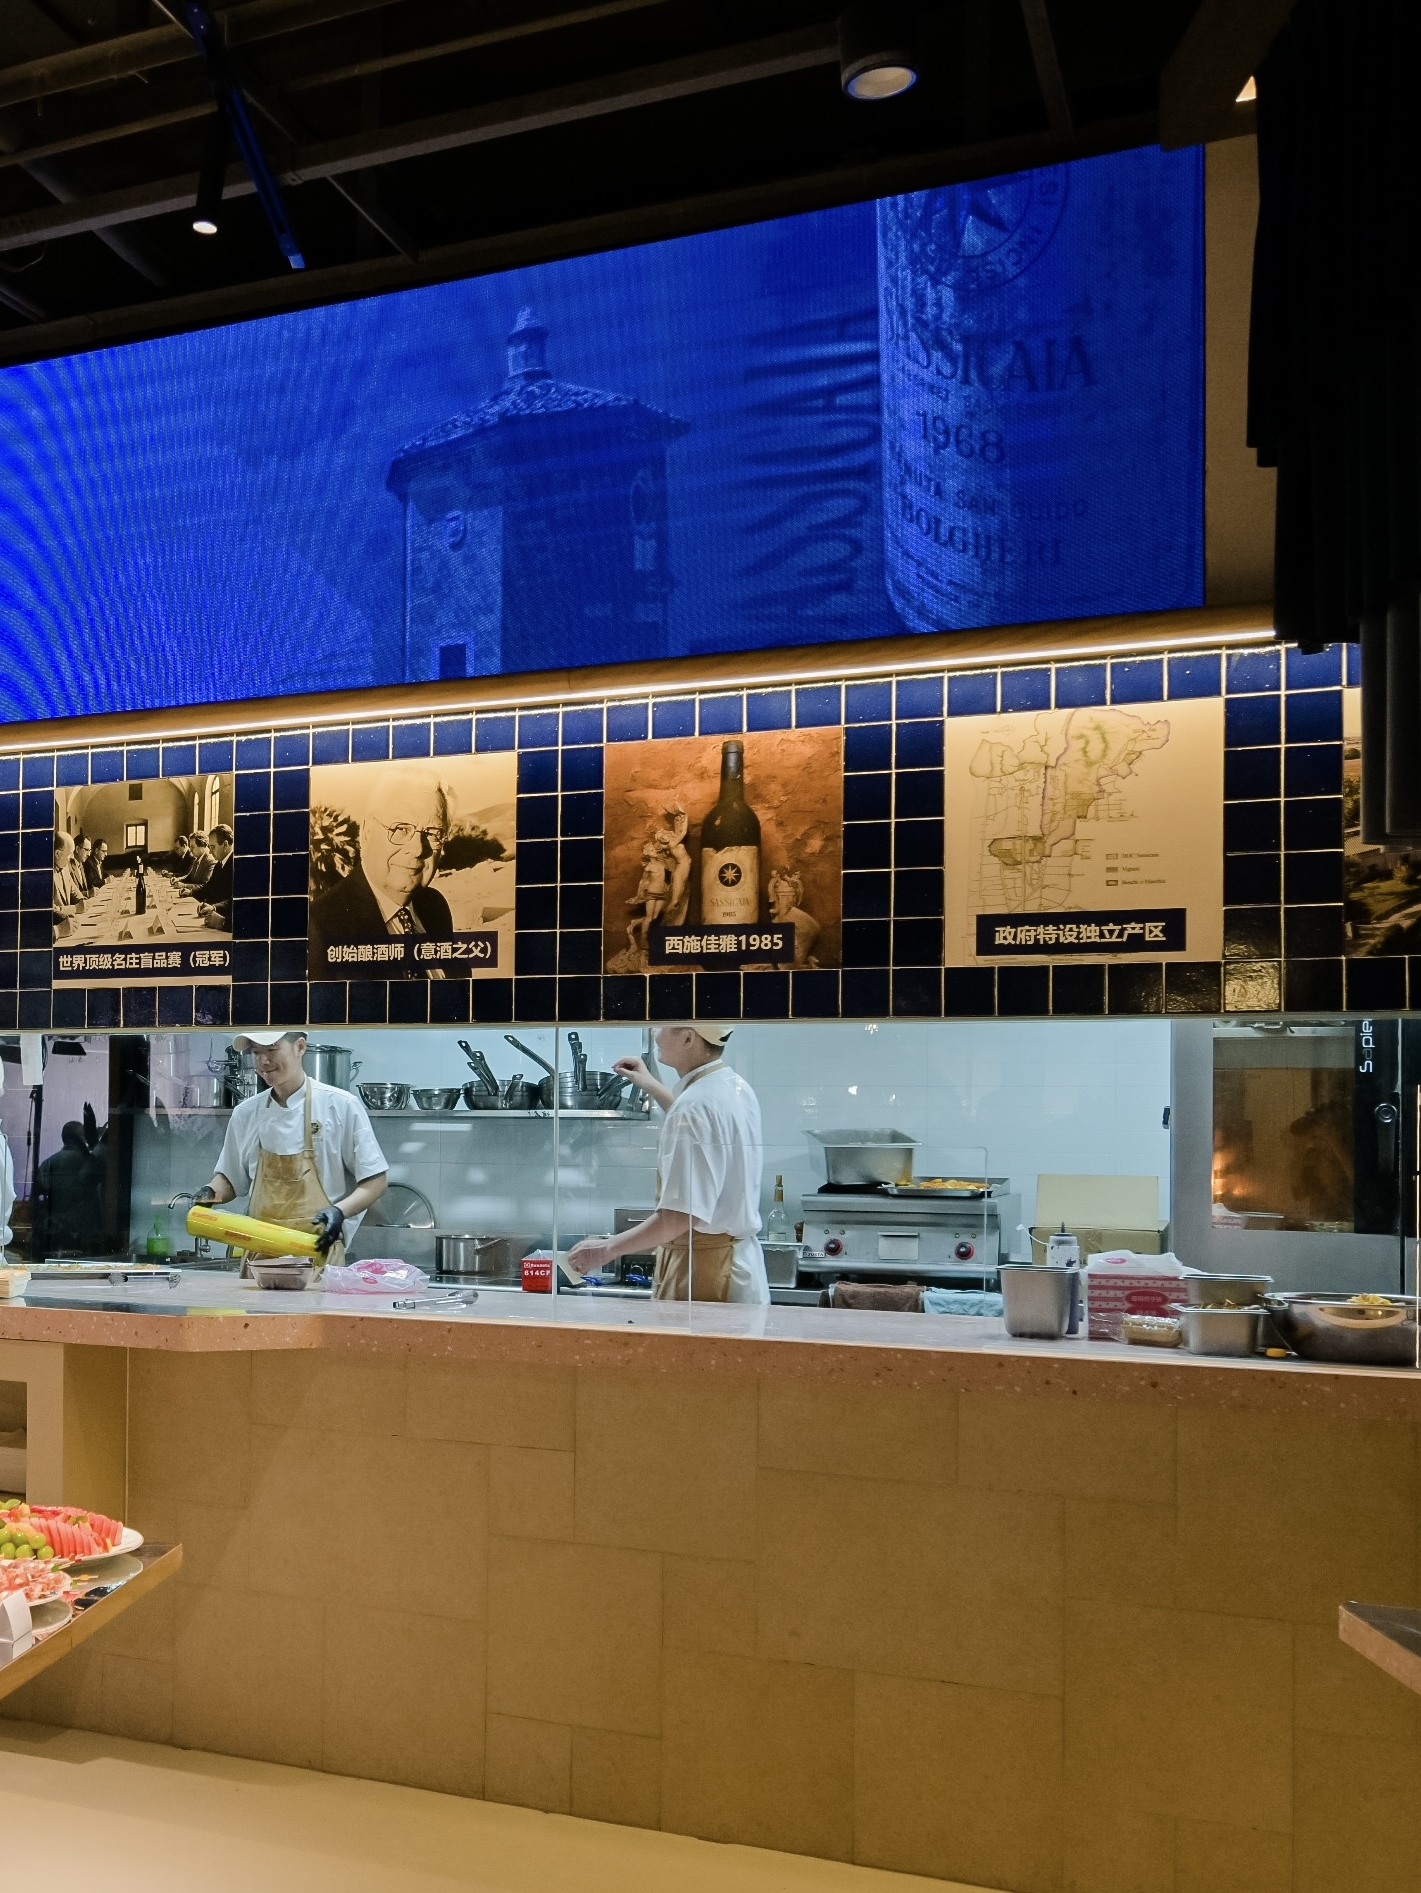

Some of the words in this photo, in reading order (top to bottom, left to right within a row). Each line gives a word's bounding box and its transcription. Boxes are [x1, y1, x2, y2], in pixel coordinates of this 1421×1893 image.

[915, 409, 1006, 466] 1968
[664, 933, 784, 955] 西施佳雅1985
[994, 920, 1167, 947] 政府特设独立产区
[1359, 1019, 1375, 1073] Sapie
